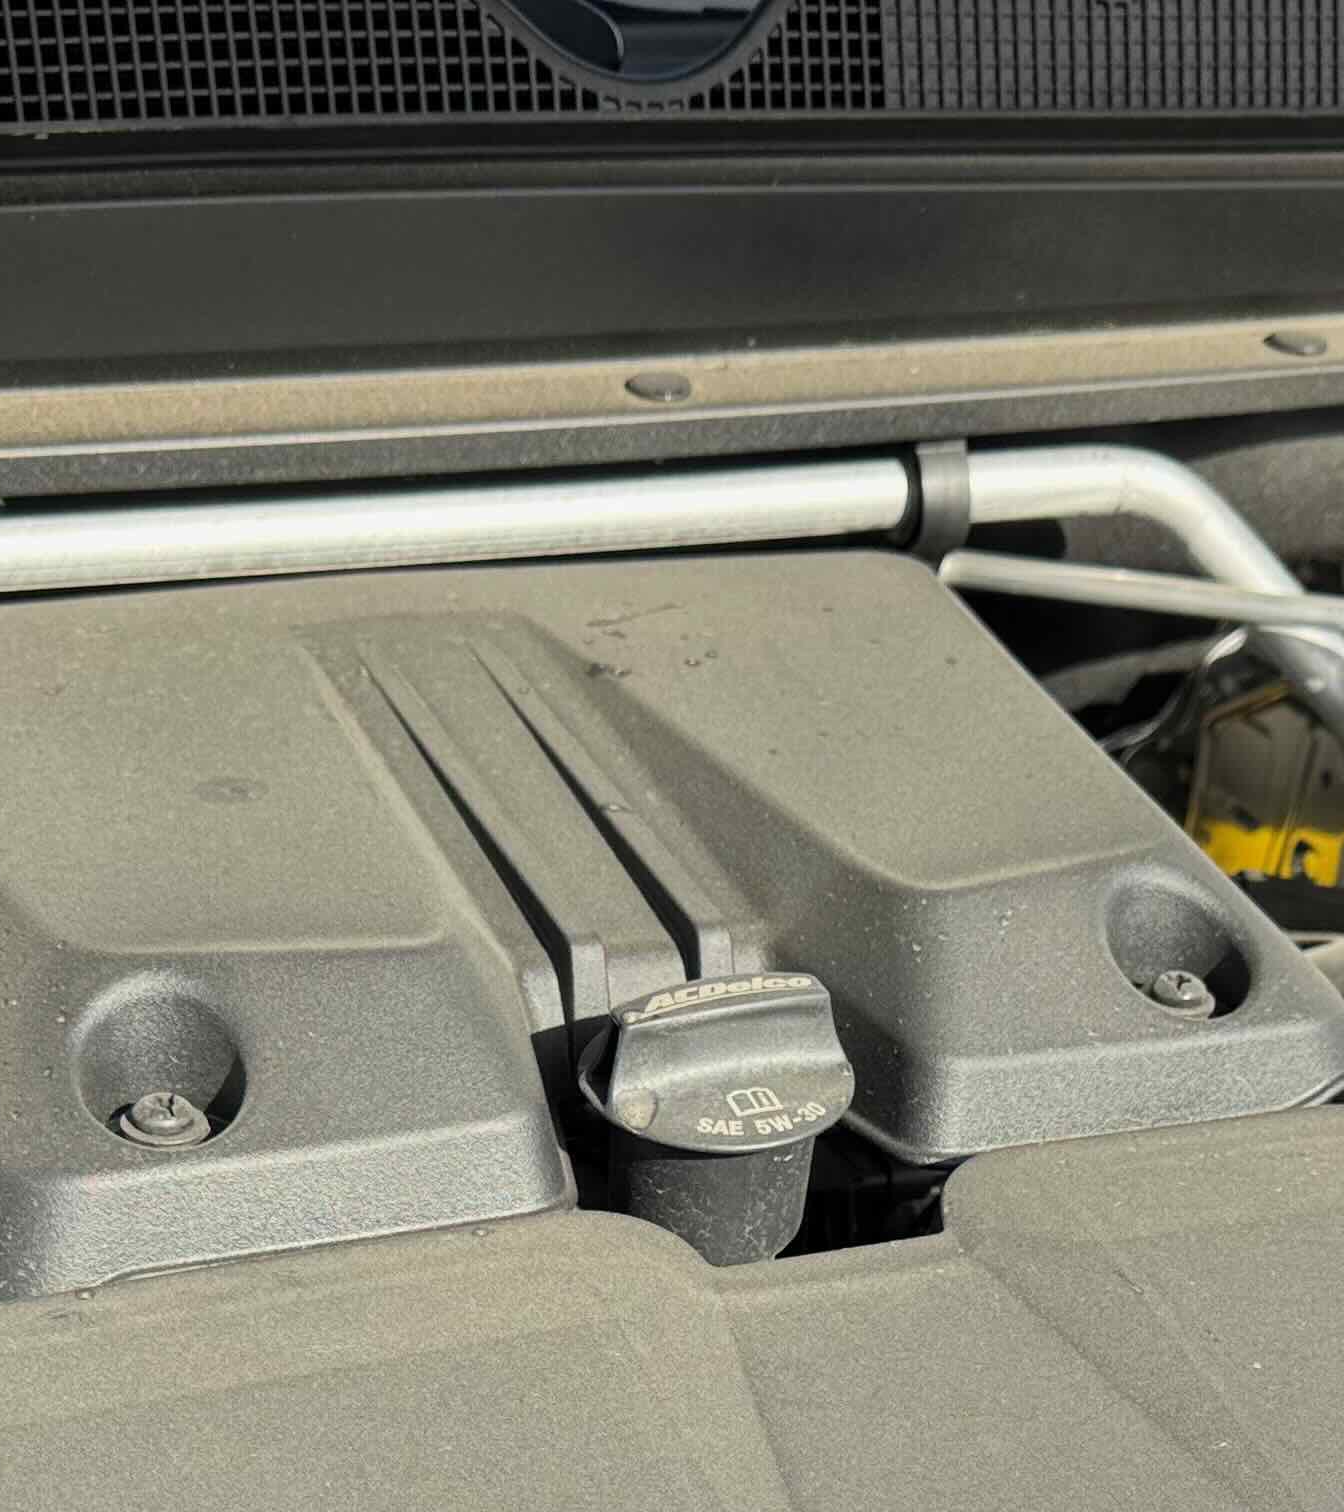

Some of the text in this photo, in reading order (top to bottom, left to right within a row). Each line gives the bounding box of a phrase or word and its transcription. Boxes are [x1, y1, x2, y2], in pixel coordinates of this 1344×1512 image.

[644, 977, 812, 1014] ACDelco
[697, 1102, 826, 1136] SAE 5W-30
